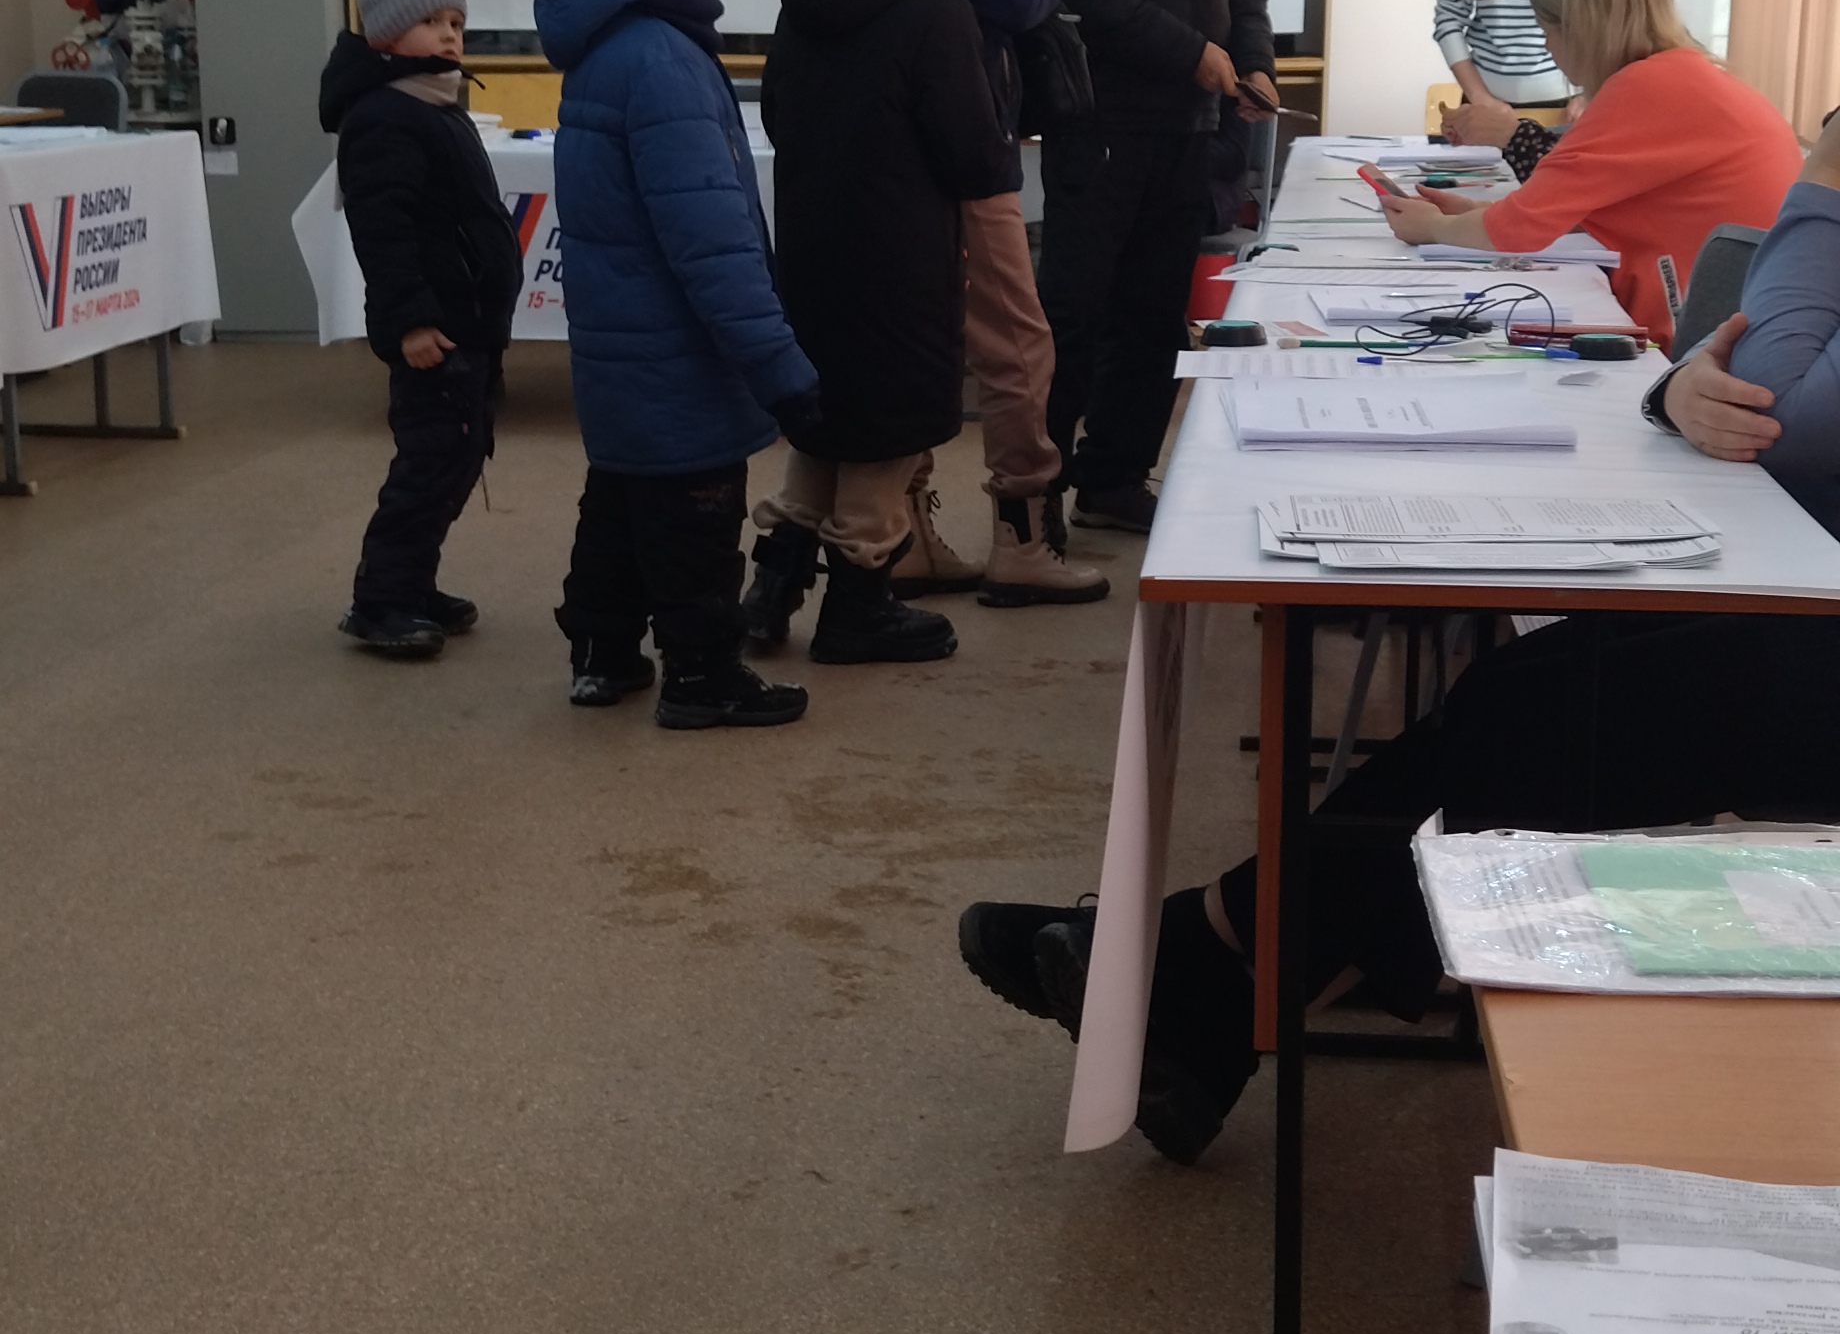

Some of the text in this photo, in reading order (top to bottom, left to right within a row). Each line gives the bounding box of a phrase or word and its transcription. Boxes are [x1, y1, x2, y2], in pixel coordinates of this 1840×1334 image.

[80, 185, 132, 219] ВЫБОРЫ
[77, 217, 148, 256] ПРЕЗИДЕНТА
[73, 258, 121, 294] РОССИИ
[95, 293, 122, 316] МАРТА
